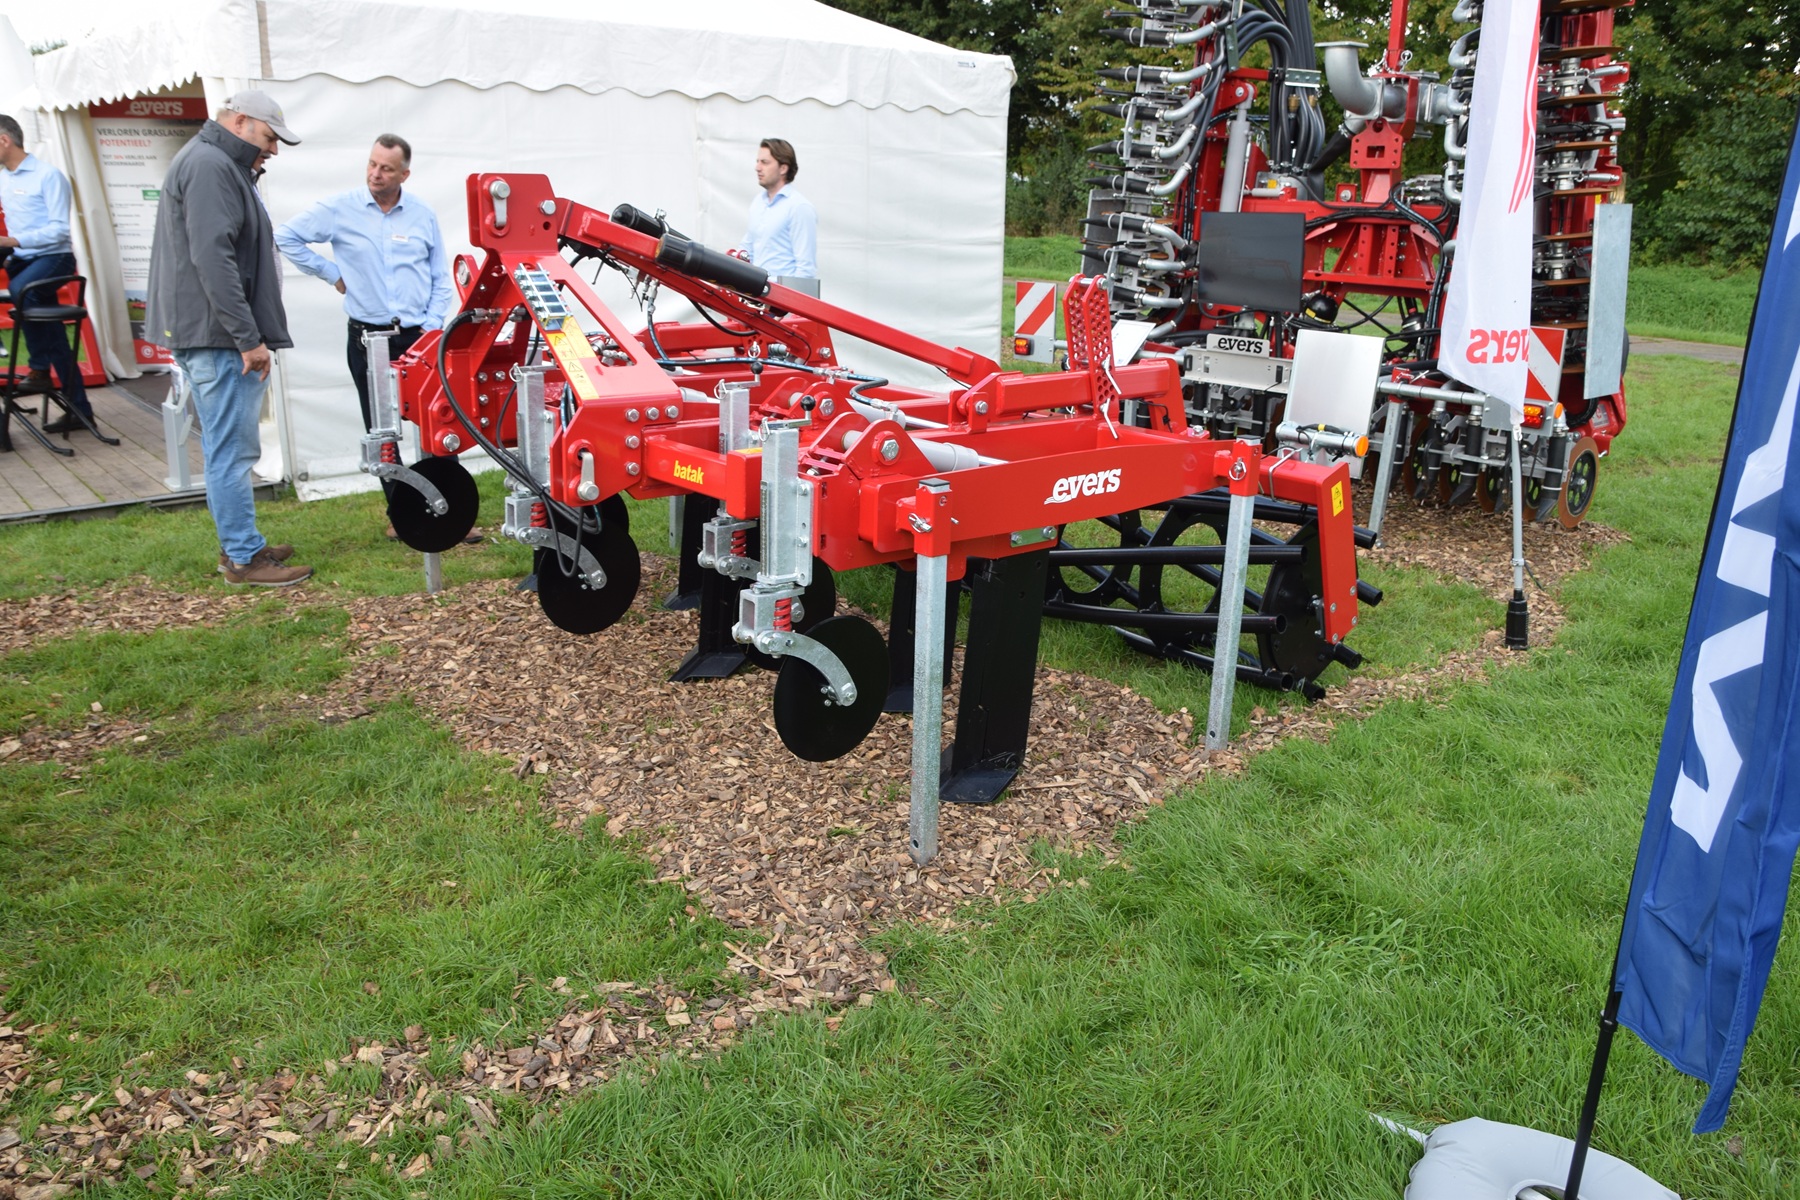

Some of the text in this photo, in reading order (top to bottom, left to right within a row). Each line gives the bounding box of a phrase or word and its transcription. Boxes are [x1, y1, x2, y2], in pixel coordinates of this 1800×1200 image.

[127, 101, 184, 116] evers
[97, 128, 186, 137] VERLOREN GRASLAND
[99, 138, 152, 148] POTENTIEEL?
[1216, 337, 1264, 354] evers
[673, 459, 705, 485] batak
[1045, 468, 1122, 504] evers
